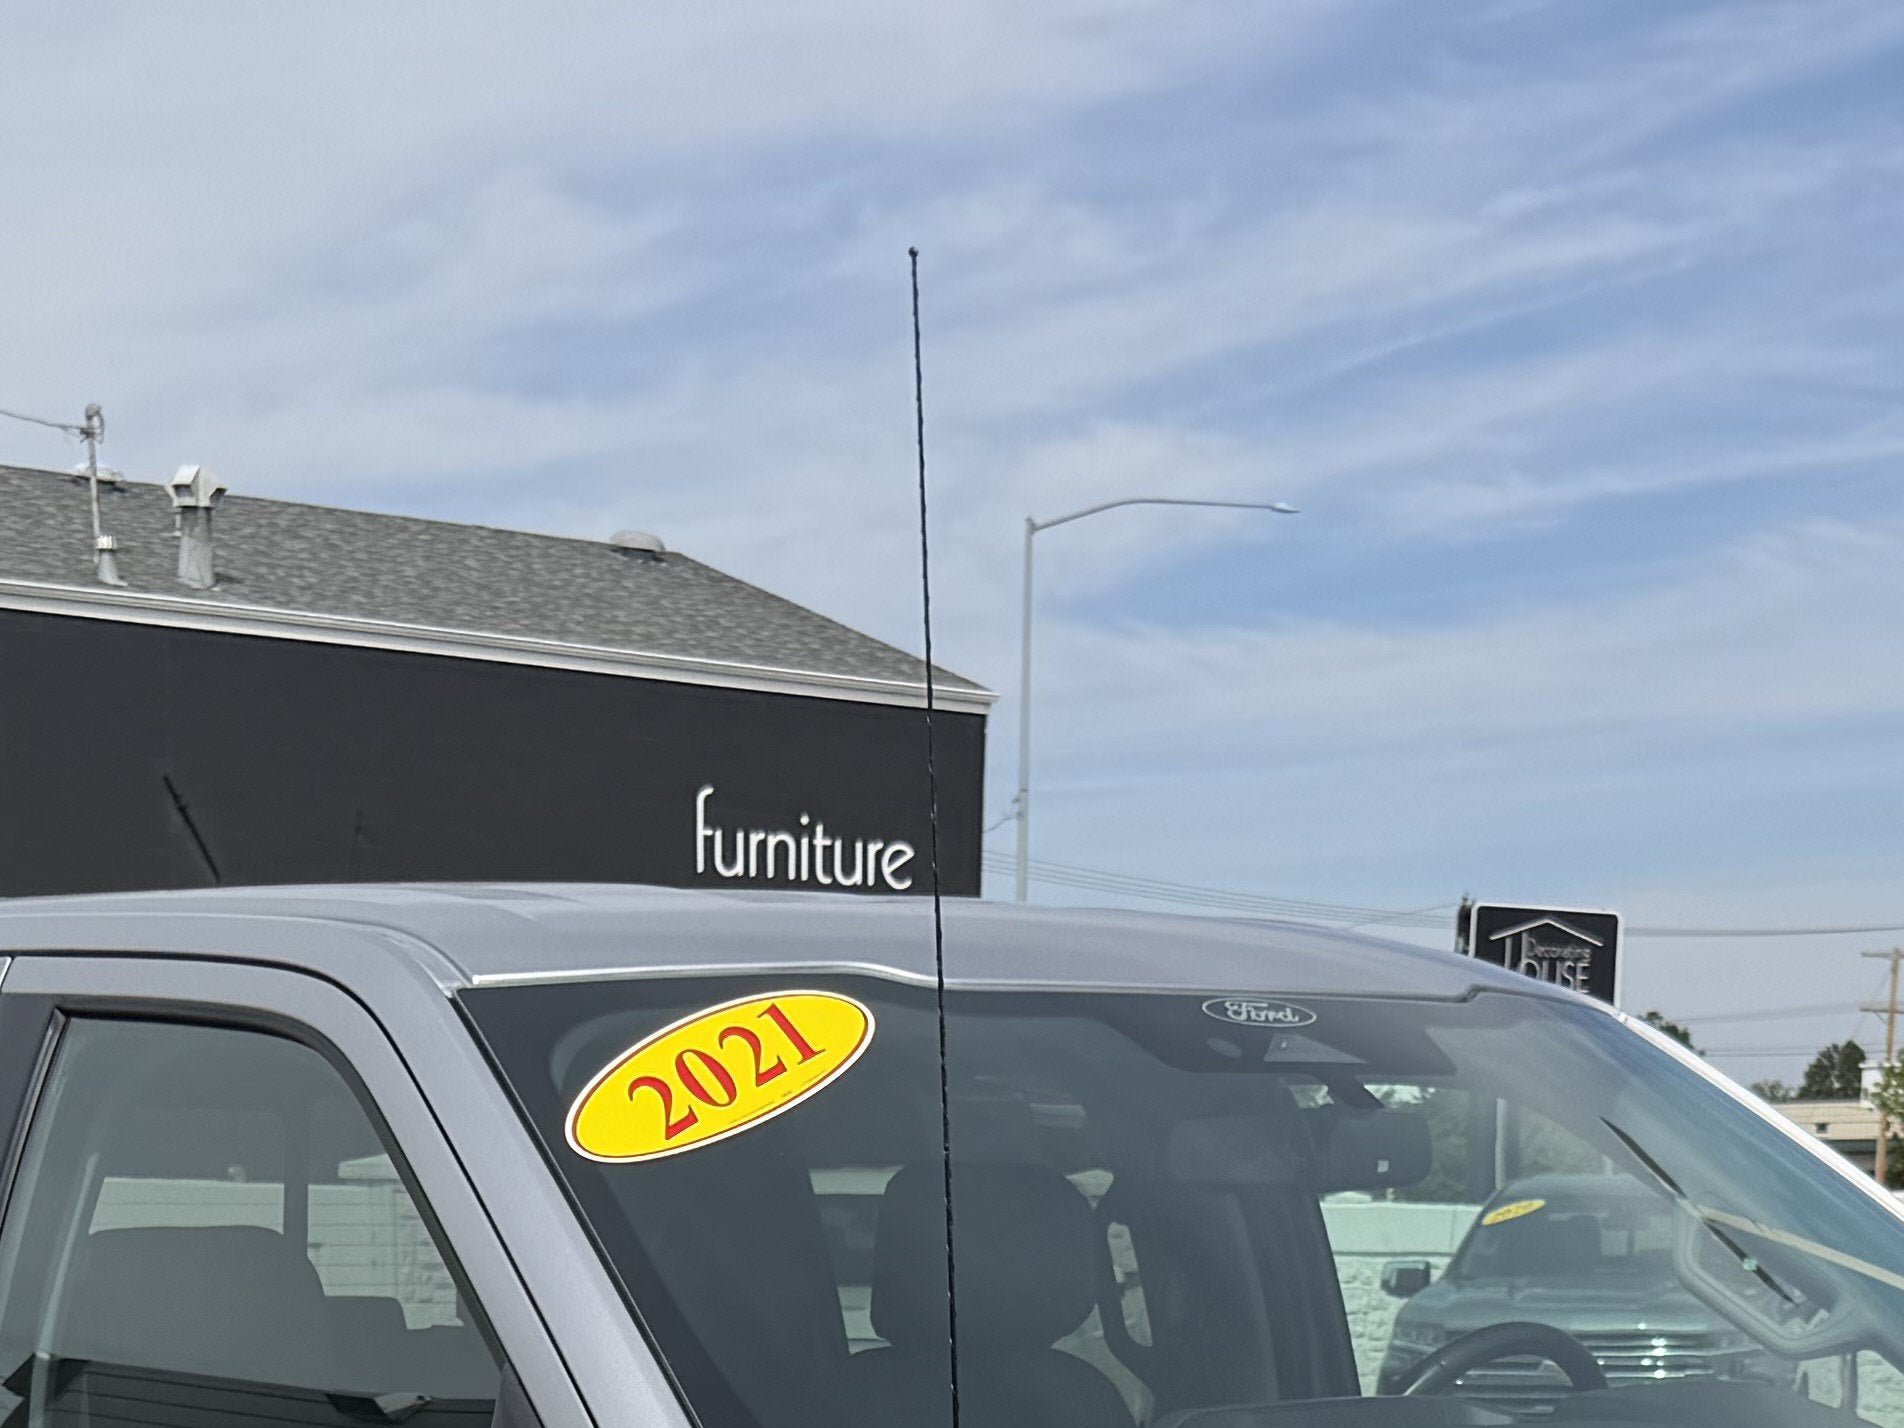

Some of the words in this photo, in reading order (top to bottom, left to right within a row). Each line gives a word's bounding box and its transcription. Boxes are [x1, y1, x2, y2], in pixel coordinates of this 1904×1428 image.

[696, 784, 915, 890] furniture
[1224, 1000, 1299, 1022] Ford
[628, 1003, 826, 1140] 2021
